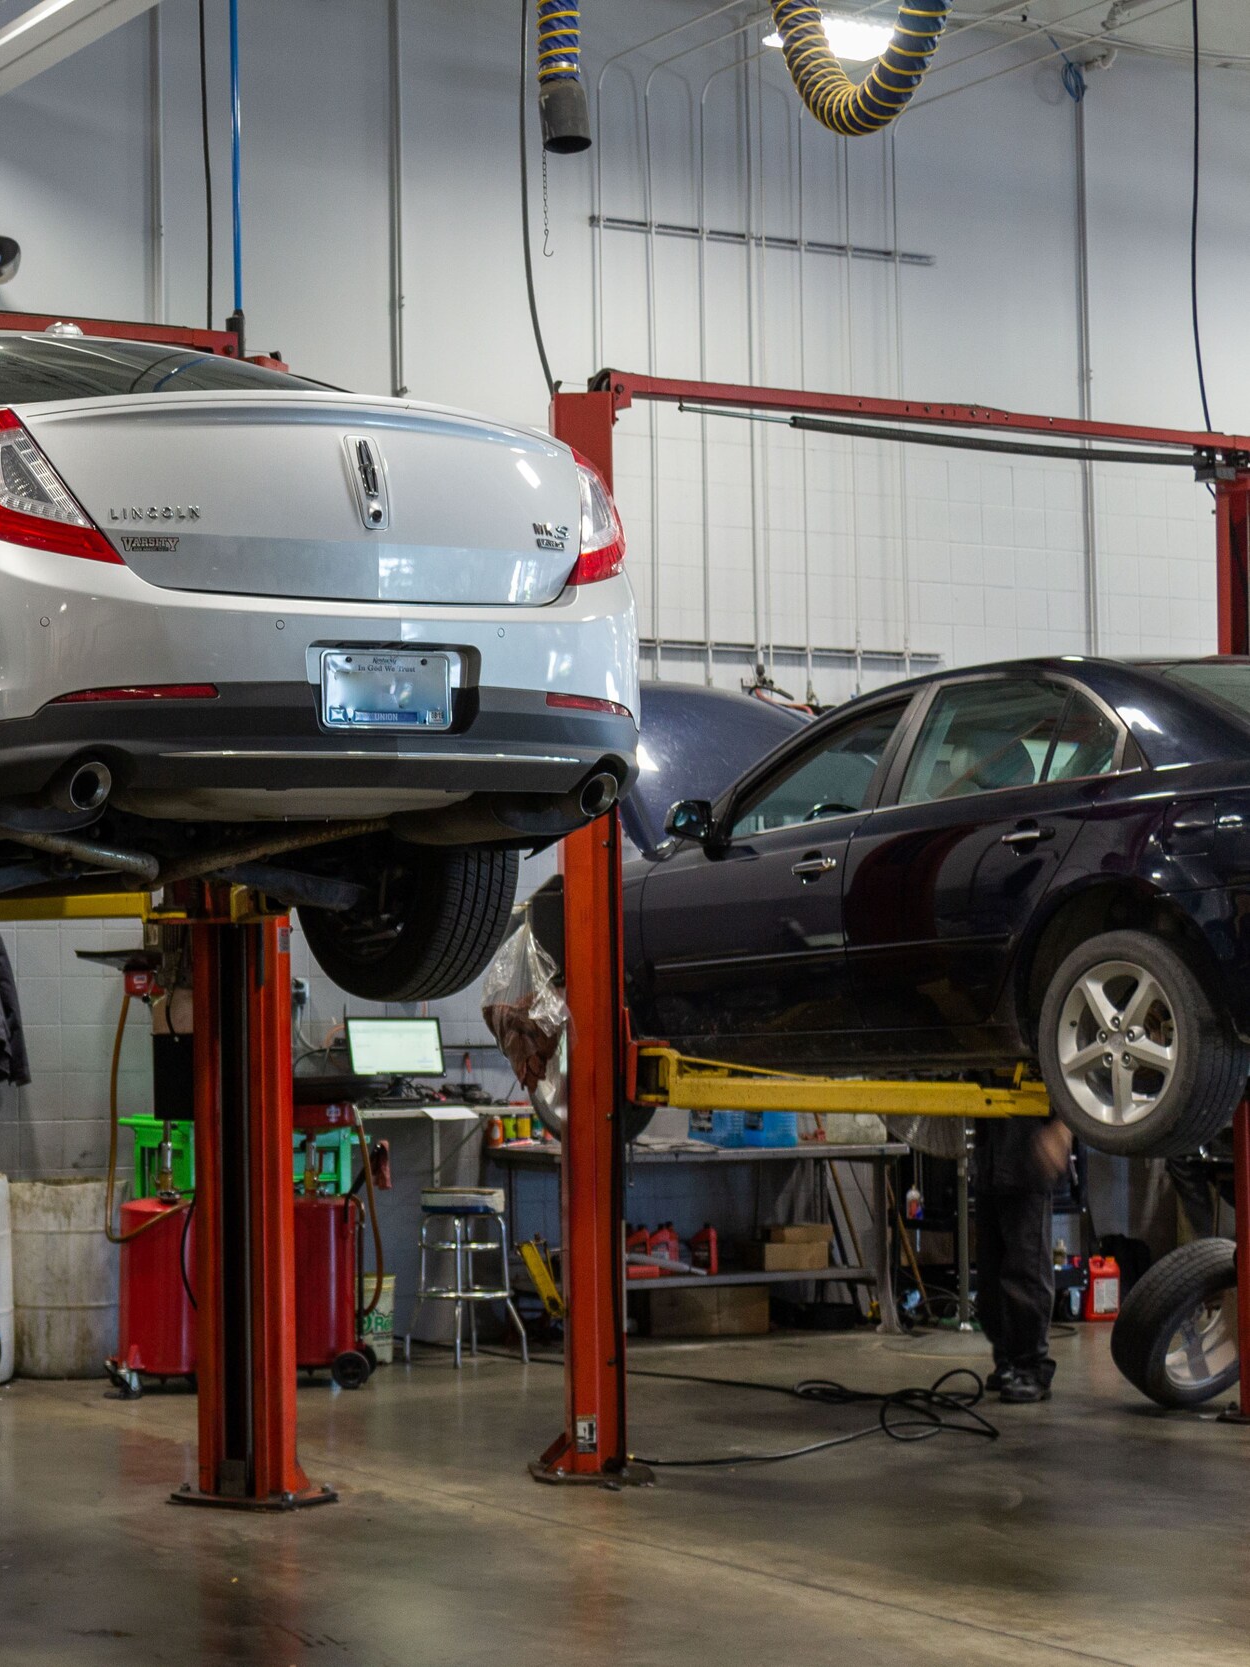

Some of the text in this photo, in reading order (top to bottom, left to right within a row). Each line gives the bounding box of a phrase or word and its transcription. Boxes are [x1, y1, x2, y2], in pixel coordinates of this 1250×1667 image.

[110, 505, 200, 520] LINCOLN
[121, 536, 179, 552] VARSITY
[399, 665, 416, 673] Trust
[374, 712, 399, 721] UNION
